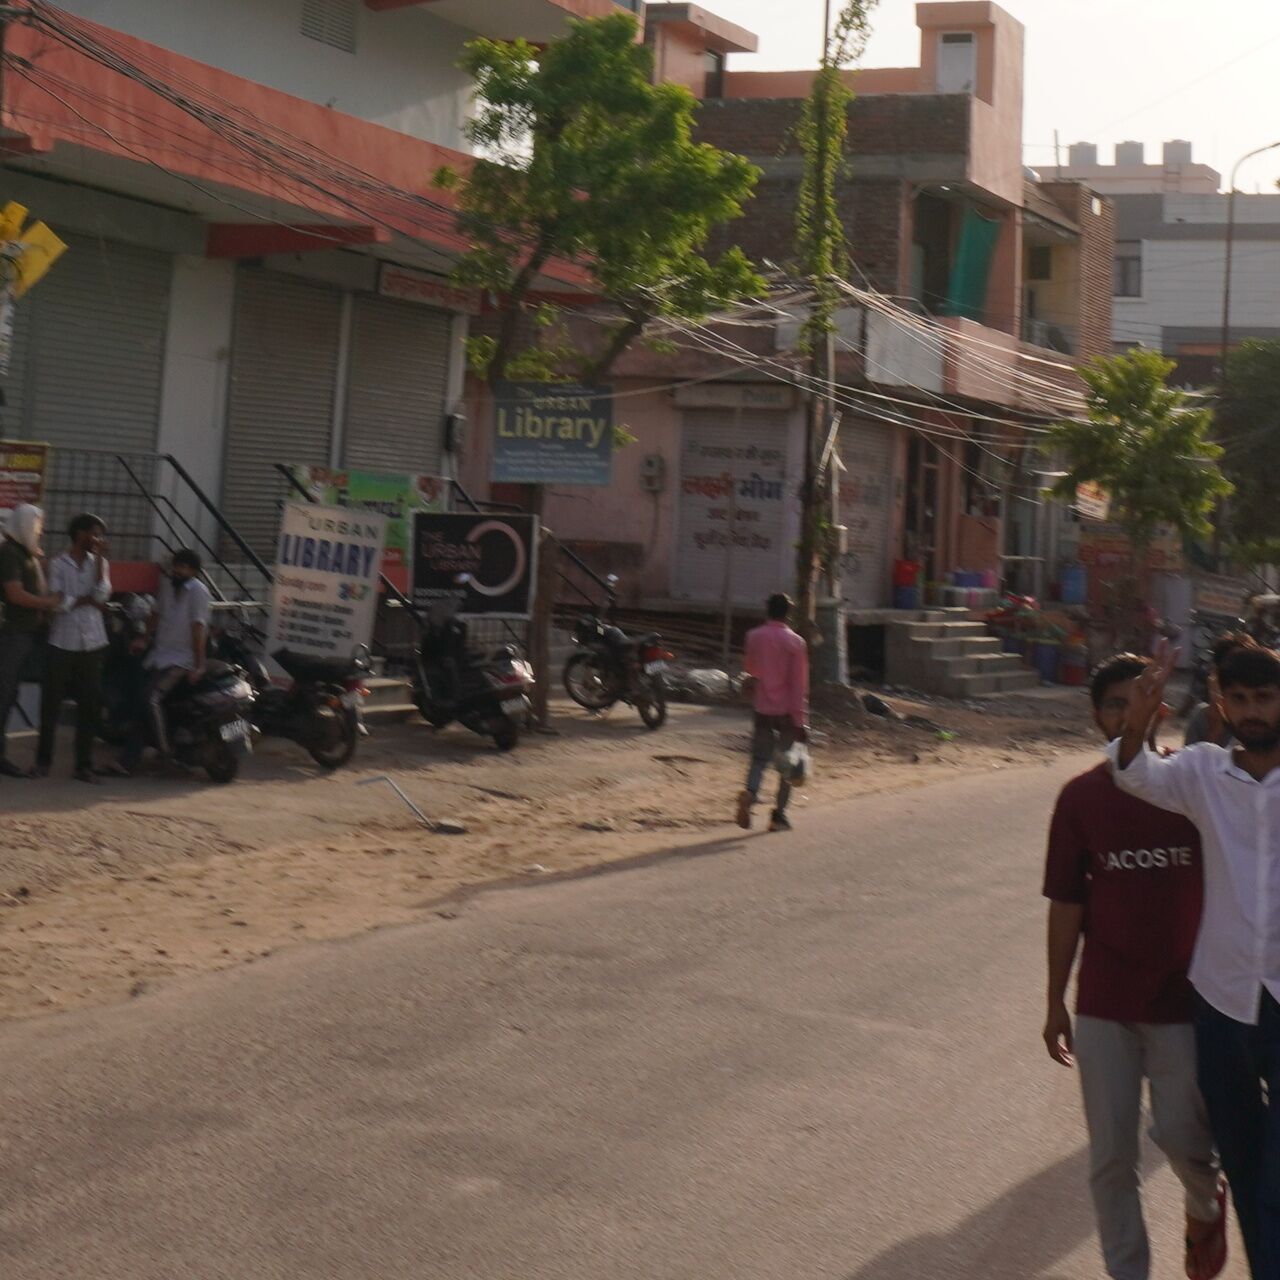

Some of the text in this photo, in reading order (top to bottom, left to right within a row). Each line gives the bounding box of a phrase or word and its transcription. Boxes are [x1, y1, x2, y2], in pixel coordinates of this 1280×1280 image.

[533, 396, 592, 412] URBAN
[497, 406, 607, 448] Library
[308, 517, 378, 539] URBAN
[279, 533, 377, 578] LIBRARY
[422, 543, 481, 561] URBAN
